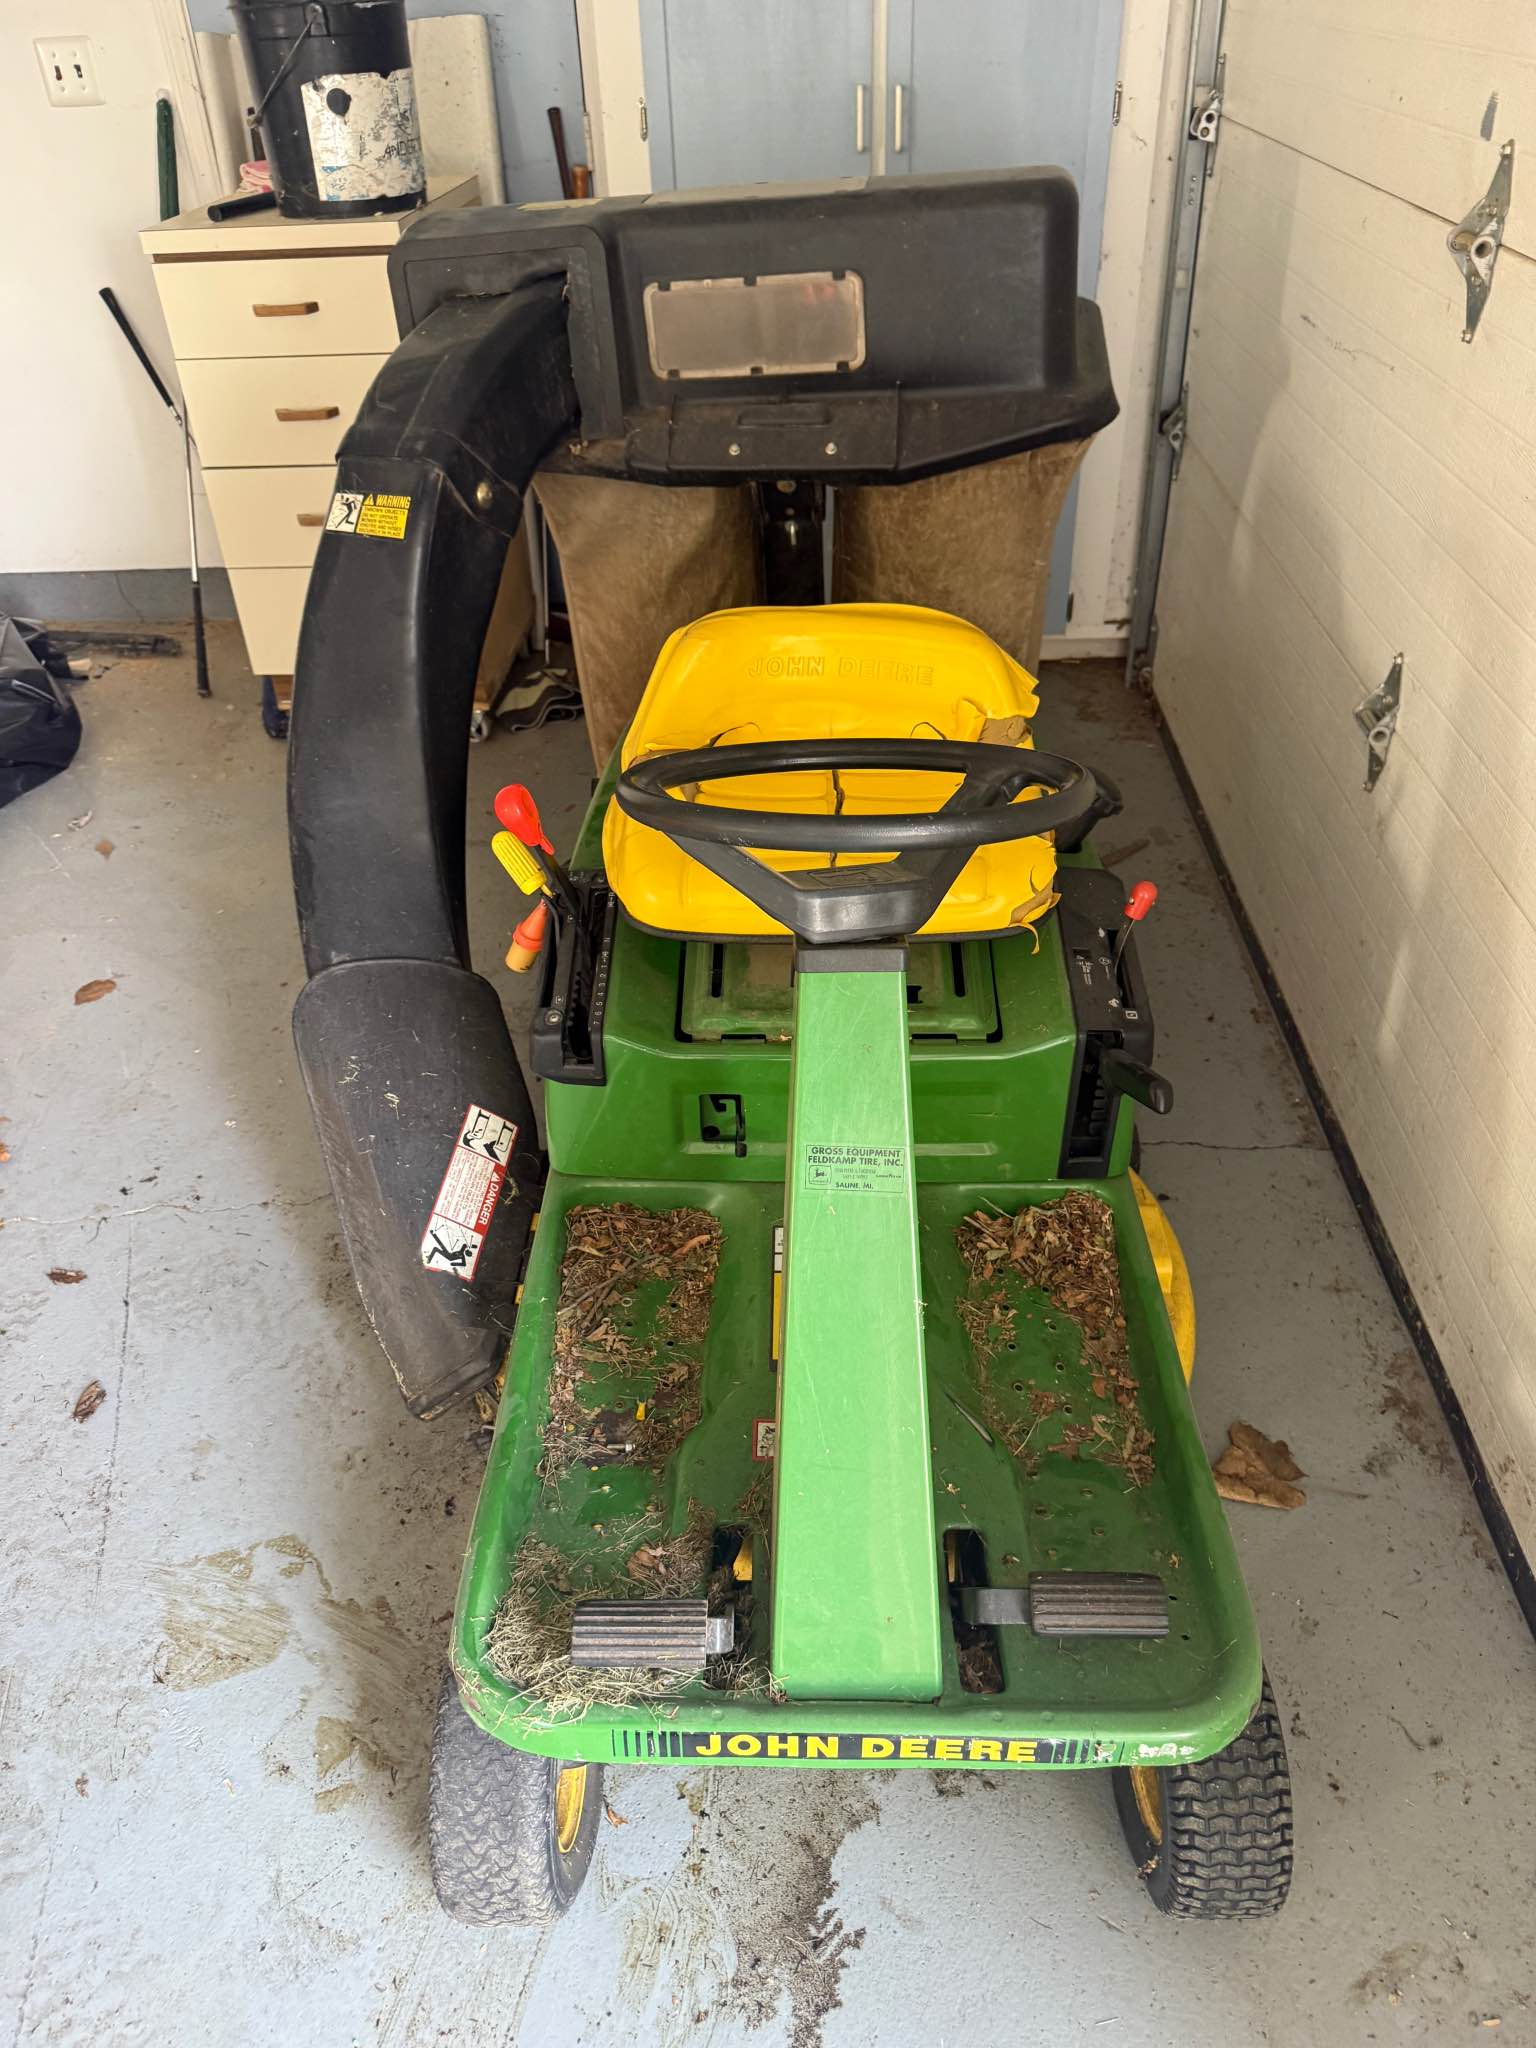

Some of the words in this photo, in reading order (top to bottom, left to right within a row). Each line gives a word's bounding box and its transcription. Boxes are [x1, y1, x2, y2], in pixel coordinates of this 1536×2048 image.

[376, 494, 412, 508] WARNING
[747, 655, 825, 678] JOHN
[838, 656, 934, 686] DEERE
[808, 1155, 857, 1165] FELDKAMP
[860, 1157, 881, 1167] TIRE,
[884, 1158, 904, 1167] INC.
[811, 1147, 844, 1156] GROSS
[846, 1148, 901, 1158] EQUIPMENT
[478, 1182, 498, 1226] DANGER
[695, 1733, 841, 1759] JOHN
[860, 1736, 1037, 1763] DEERE
